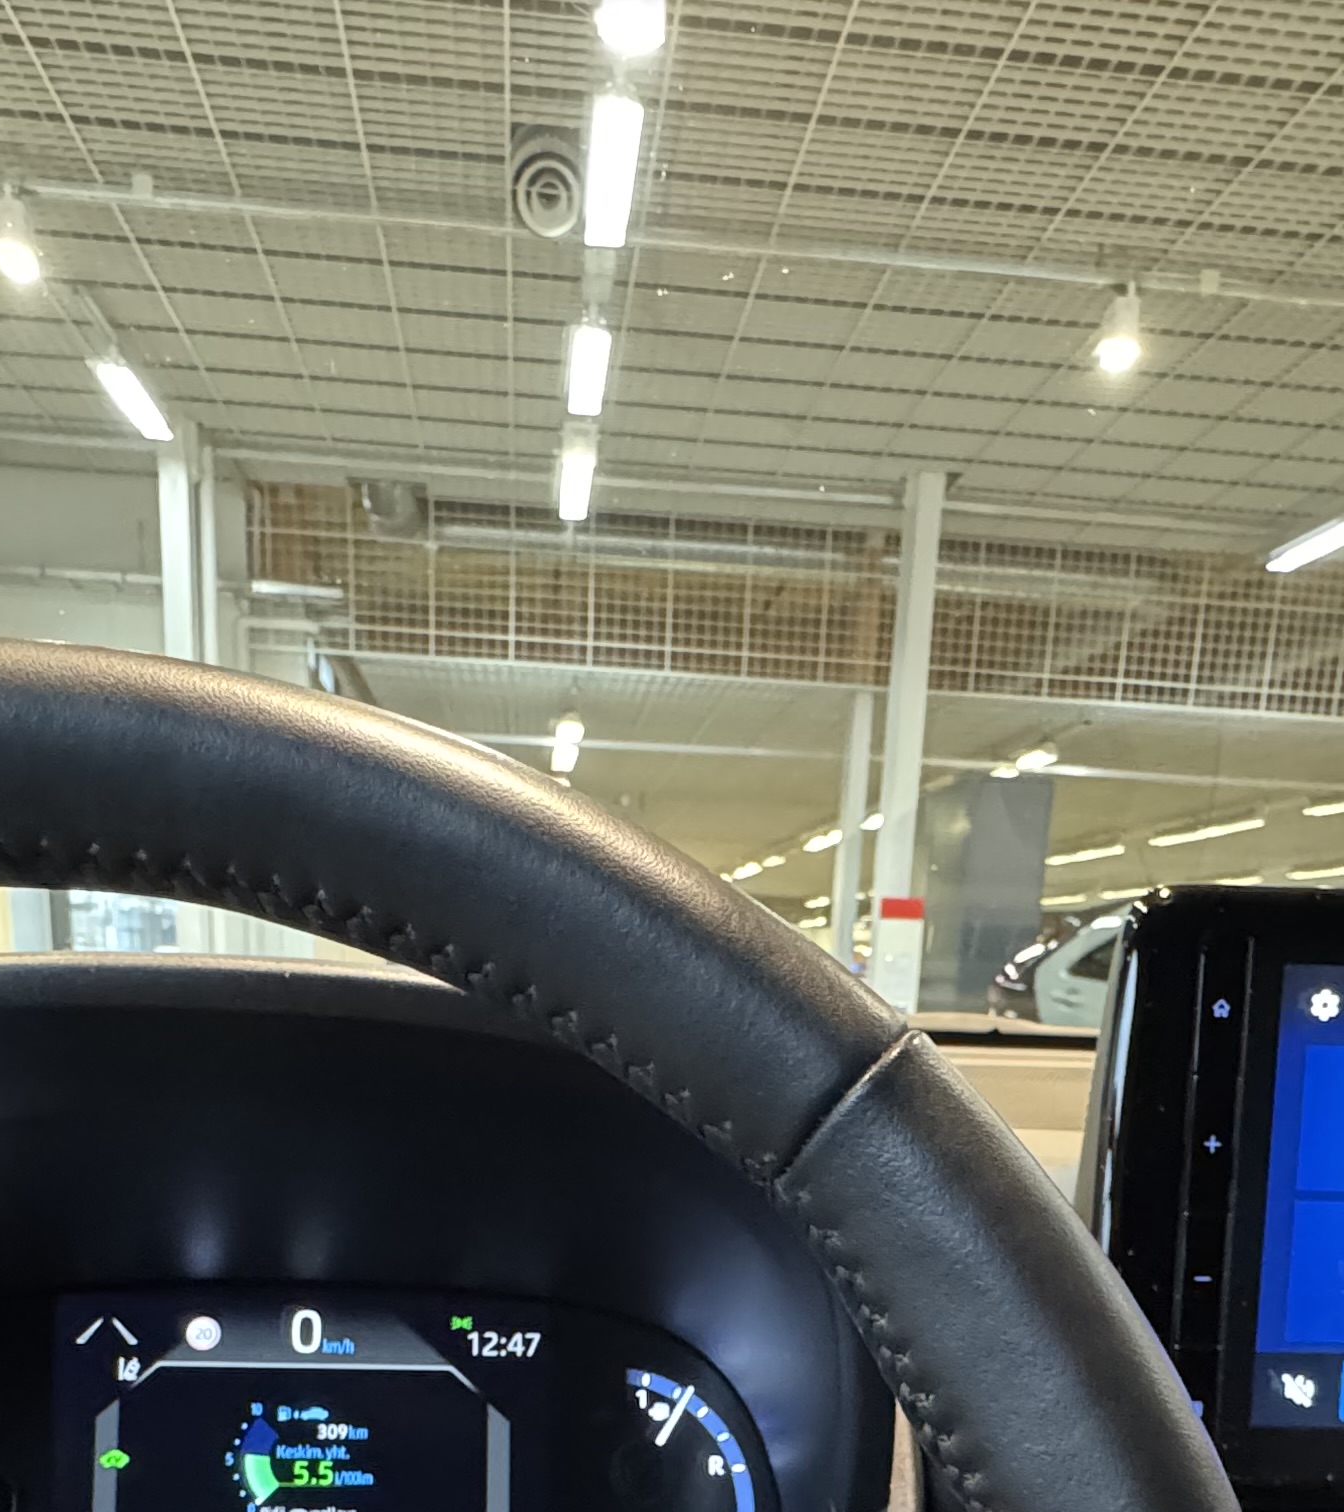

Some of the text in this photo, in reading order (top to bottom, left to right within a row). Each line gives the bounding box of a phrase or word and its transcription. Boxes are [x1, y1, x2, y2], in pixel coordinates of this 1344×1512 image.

[195, 1328, 213, 1340] 20
[322, 1337, 355, 1355] km/h
[467, 1330, 541, 1357] 12:47
[225, 1452, 235, 1467] 5
[708, 1455, 725, 1476] R
